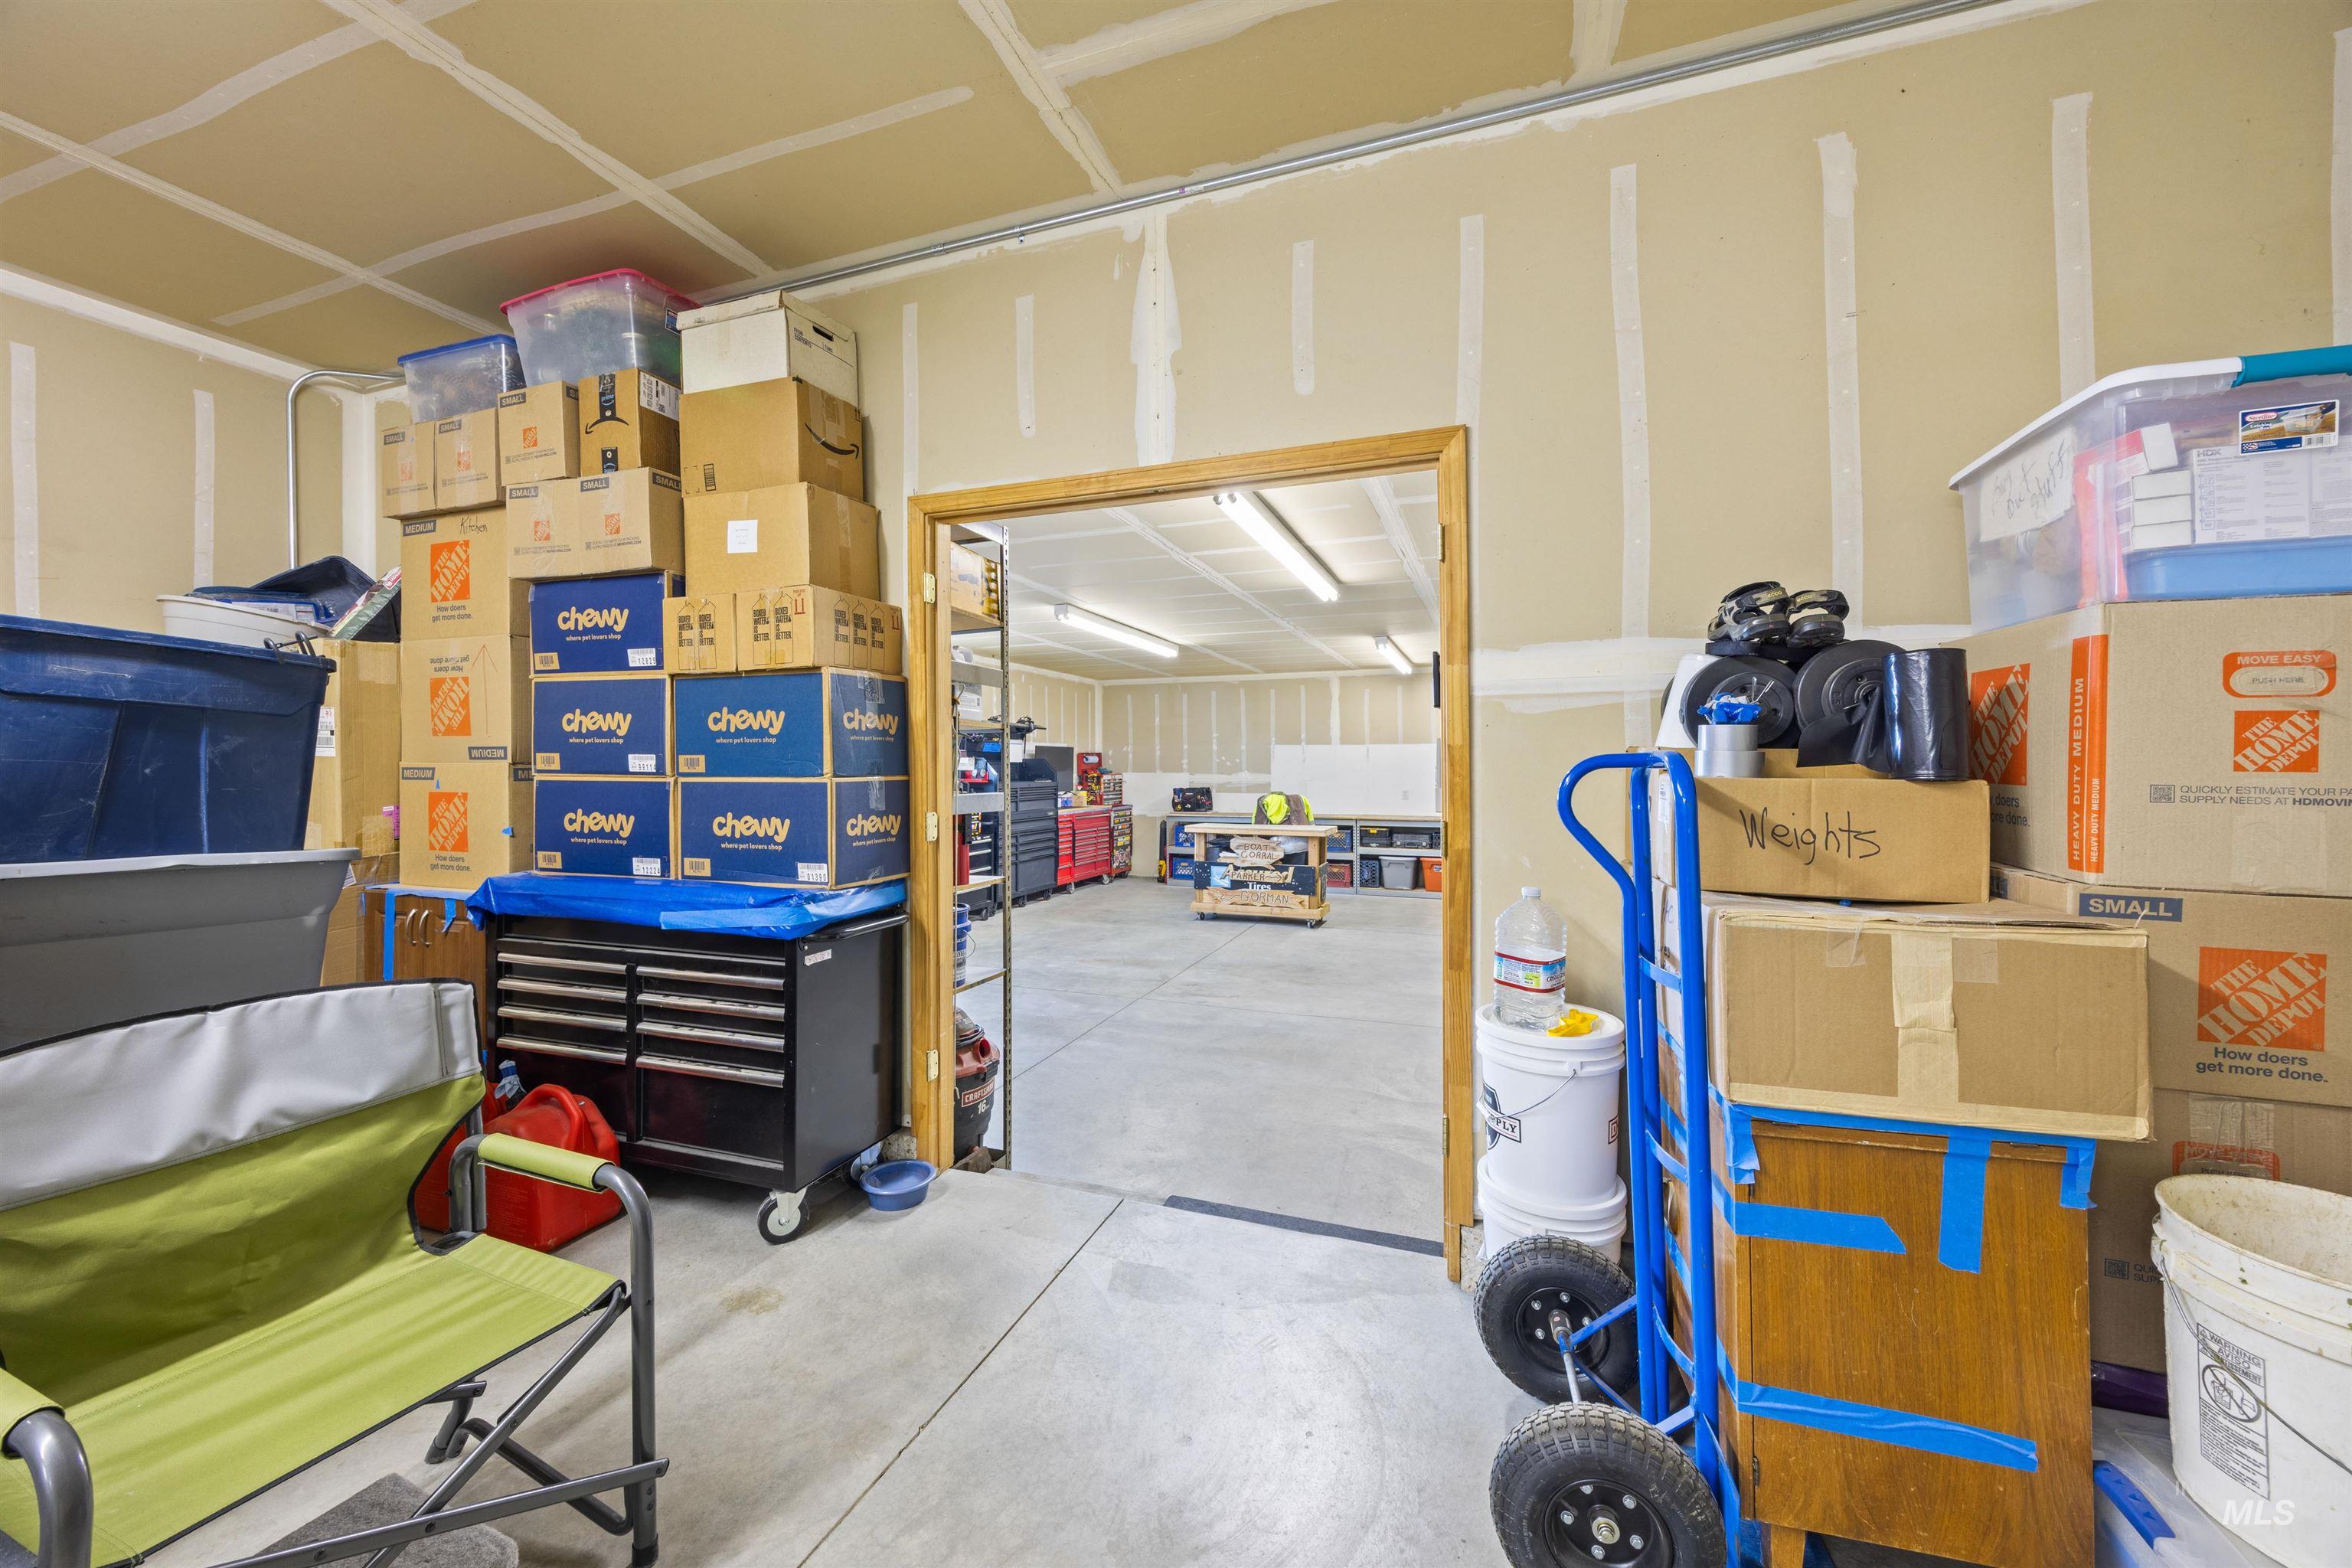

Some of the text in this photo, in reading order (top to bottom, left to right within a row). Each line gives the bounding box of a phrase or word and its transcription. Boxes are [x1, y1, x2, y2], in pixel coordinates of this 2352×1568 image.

[794, 334, 812, 348] CONTENTS
[501, 393, 524, 406] SMALL
[440, 421, 460, 432] SMALL
[385, 434, 404, 443] SMALL
[2197, 449, 2222, 458] HDX
[511, 488, 536, 498] SMALL
[583, 479, 606, 490] SMALL
[405, 522, 434, 534] MEDIUM
[433, 549, 450, 572] THE
[431, 540, 469, 602] HOME
[445, 560, 469, 601] DEPOT
[436, 603, 466, 613] How doers
[753, 609, 766, 617] BOXED
[775, 606, 789, 615] BOXED
[432, 615, 441, 623] get
[457, 612, 472, 621] done.
[557, 606, 629, 632] chewy
[699, 613, 711, 622] BOXED
[582, 634, 591, 642] pet
[2237, 654, 2322, 665] MOVE EASY
[432, 678, 453, 716] DEPOT
[1975, 680, 1998, 726] THE
[433, 677, 469, 737] HOME
[562, 708, 632, 737] chewy
[708, 707, 786, 735] chewy
[843, 708, 899, 735] chewy
[1971, 665, 2030, 779] HOME
[2241, 716, 2279, 742] THE
[585, 737, 594, 745] pet
[763, 736, 777, 744] shop
[1989, 707, 2028, 784] DEPOT
[2233, 710, 2321, 772] HOME
[472, 748, 505, 758] MEDIUM
[2266, 733, 2319, 773] DEPOT
[403, 769, 433, 778] MEDIUM
[2073, 677, 2084, 861] HEAVY DUTY MEDIUM
[2180, 785, 2233, 795] QUICKLY
[2236, 786, 2296, 795] ESTIMATE
[2298, 787, 2336, 797] YOUR
[2180, 795, 2226, 805] SUPPLY
[2230, 795, 2272, 805] NEEDS
[2274, 797, 2290, 805] AT
[431, 798, 449, 822] THE
[1995, 795, 2020, 808] doers
[429, 792, 469, 851] HOME
[564, 808, 635, 838] chewy
[713, 812, 790, 843] chewy
[846, 813, 901, 837] chewy
[1990, 812, 2030, 828] ore done.
[2090, 777, 2101, 863] HEAVY DUTY MEDIUM
[443, 815, 468, 851] DEPOT
[1740, 806, 1881, 866] Weights
[768, 843, 782, 851] shop
[1241, 851, 1277, 861] CORRAL
[1244, 843, 1271, 851] BOAT
[430, 863, 439, 871] get
[456, 863, 472, 872] done.
[435, 854, 465, 863] How doers
[1230, 871, 1265, 881] PARKER
[1247, 881, 1272, 890] Tires
[1240, 890, 1290, 904] GORMAN
[2089, 898, 2173, 917] SMALL
[2210, 959, 2264, 997] THE
[2198, 952, 2327, 1044] HOME
[2246, 989, 2326, 1047] DEPOT
[2213, 1047, 2308, 1067] How doers
[2196, 1061, 2328, 1083] get more done.
[1495, 1117, 1517, 1134] PLY
[2209, 1332, 2262, 1367] WARNING
[2217, 1348, 2251, 1369] AVISO
